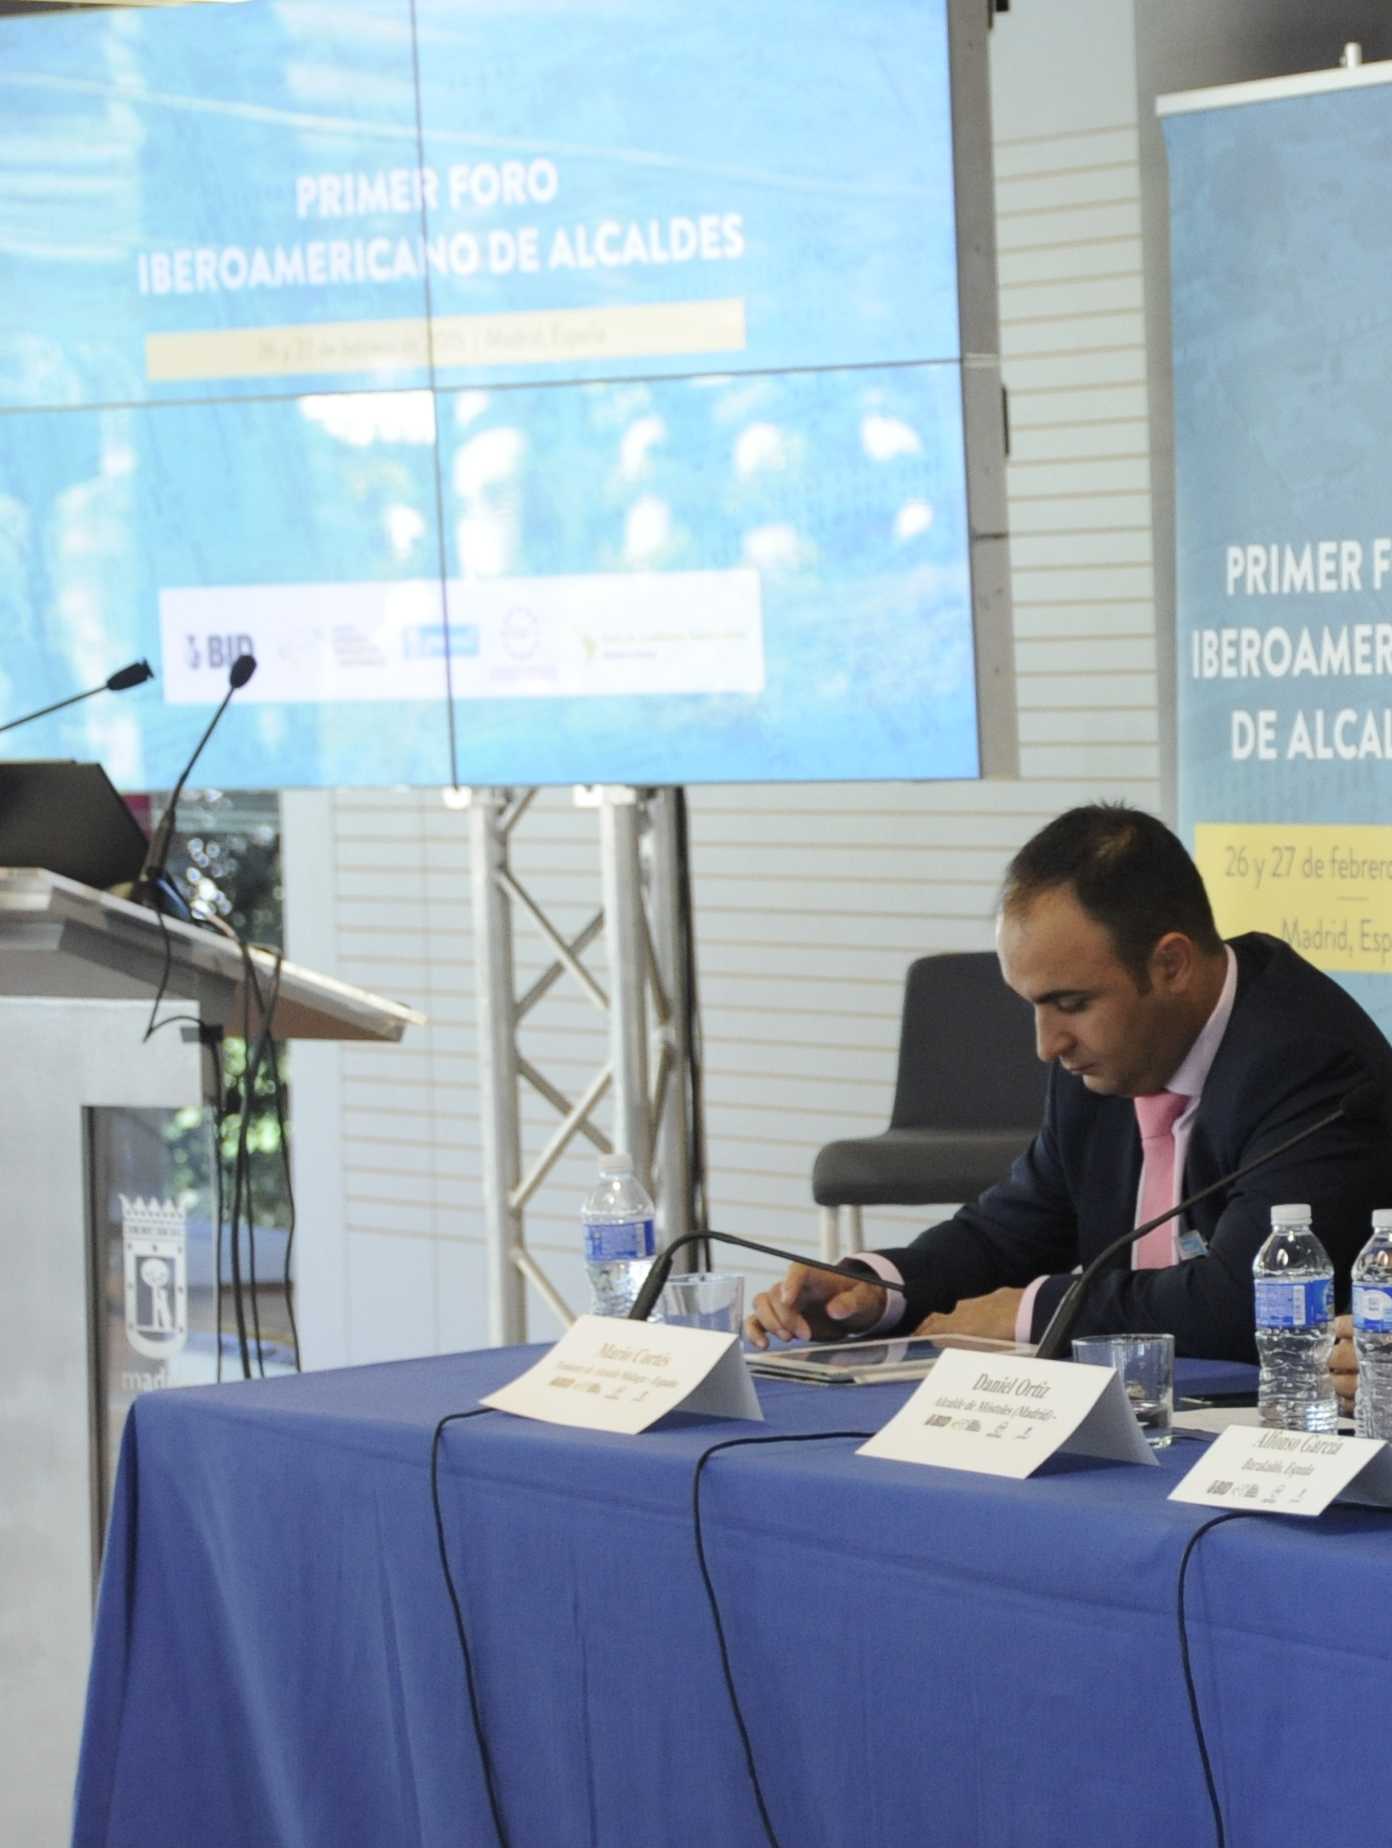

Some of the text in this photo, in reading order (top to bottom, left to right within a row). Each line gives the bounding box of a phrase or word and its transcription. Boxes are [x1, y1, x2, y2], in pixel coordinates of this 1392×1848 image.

[295, 158, 558, 219] PRIMER FORO
[138, 212, 745, 294] IBEROAMERICANO DE ALCALDES
[1226, 540, 1363, 596] PRIMER
[1231, 708, 1278, 761] DE
[1225, 845, 1250, 879] 26
[1254, 857, 1266, 889] y
[1271, 846, 1297, 878] 27
[1303, 848, 1325, 880] de
[1282, 918, 1353, 958] Madrid,
[972, 1373, 1052, 1399] Daniel Ortiz
